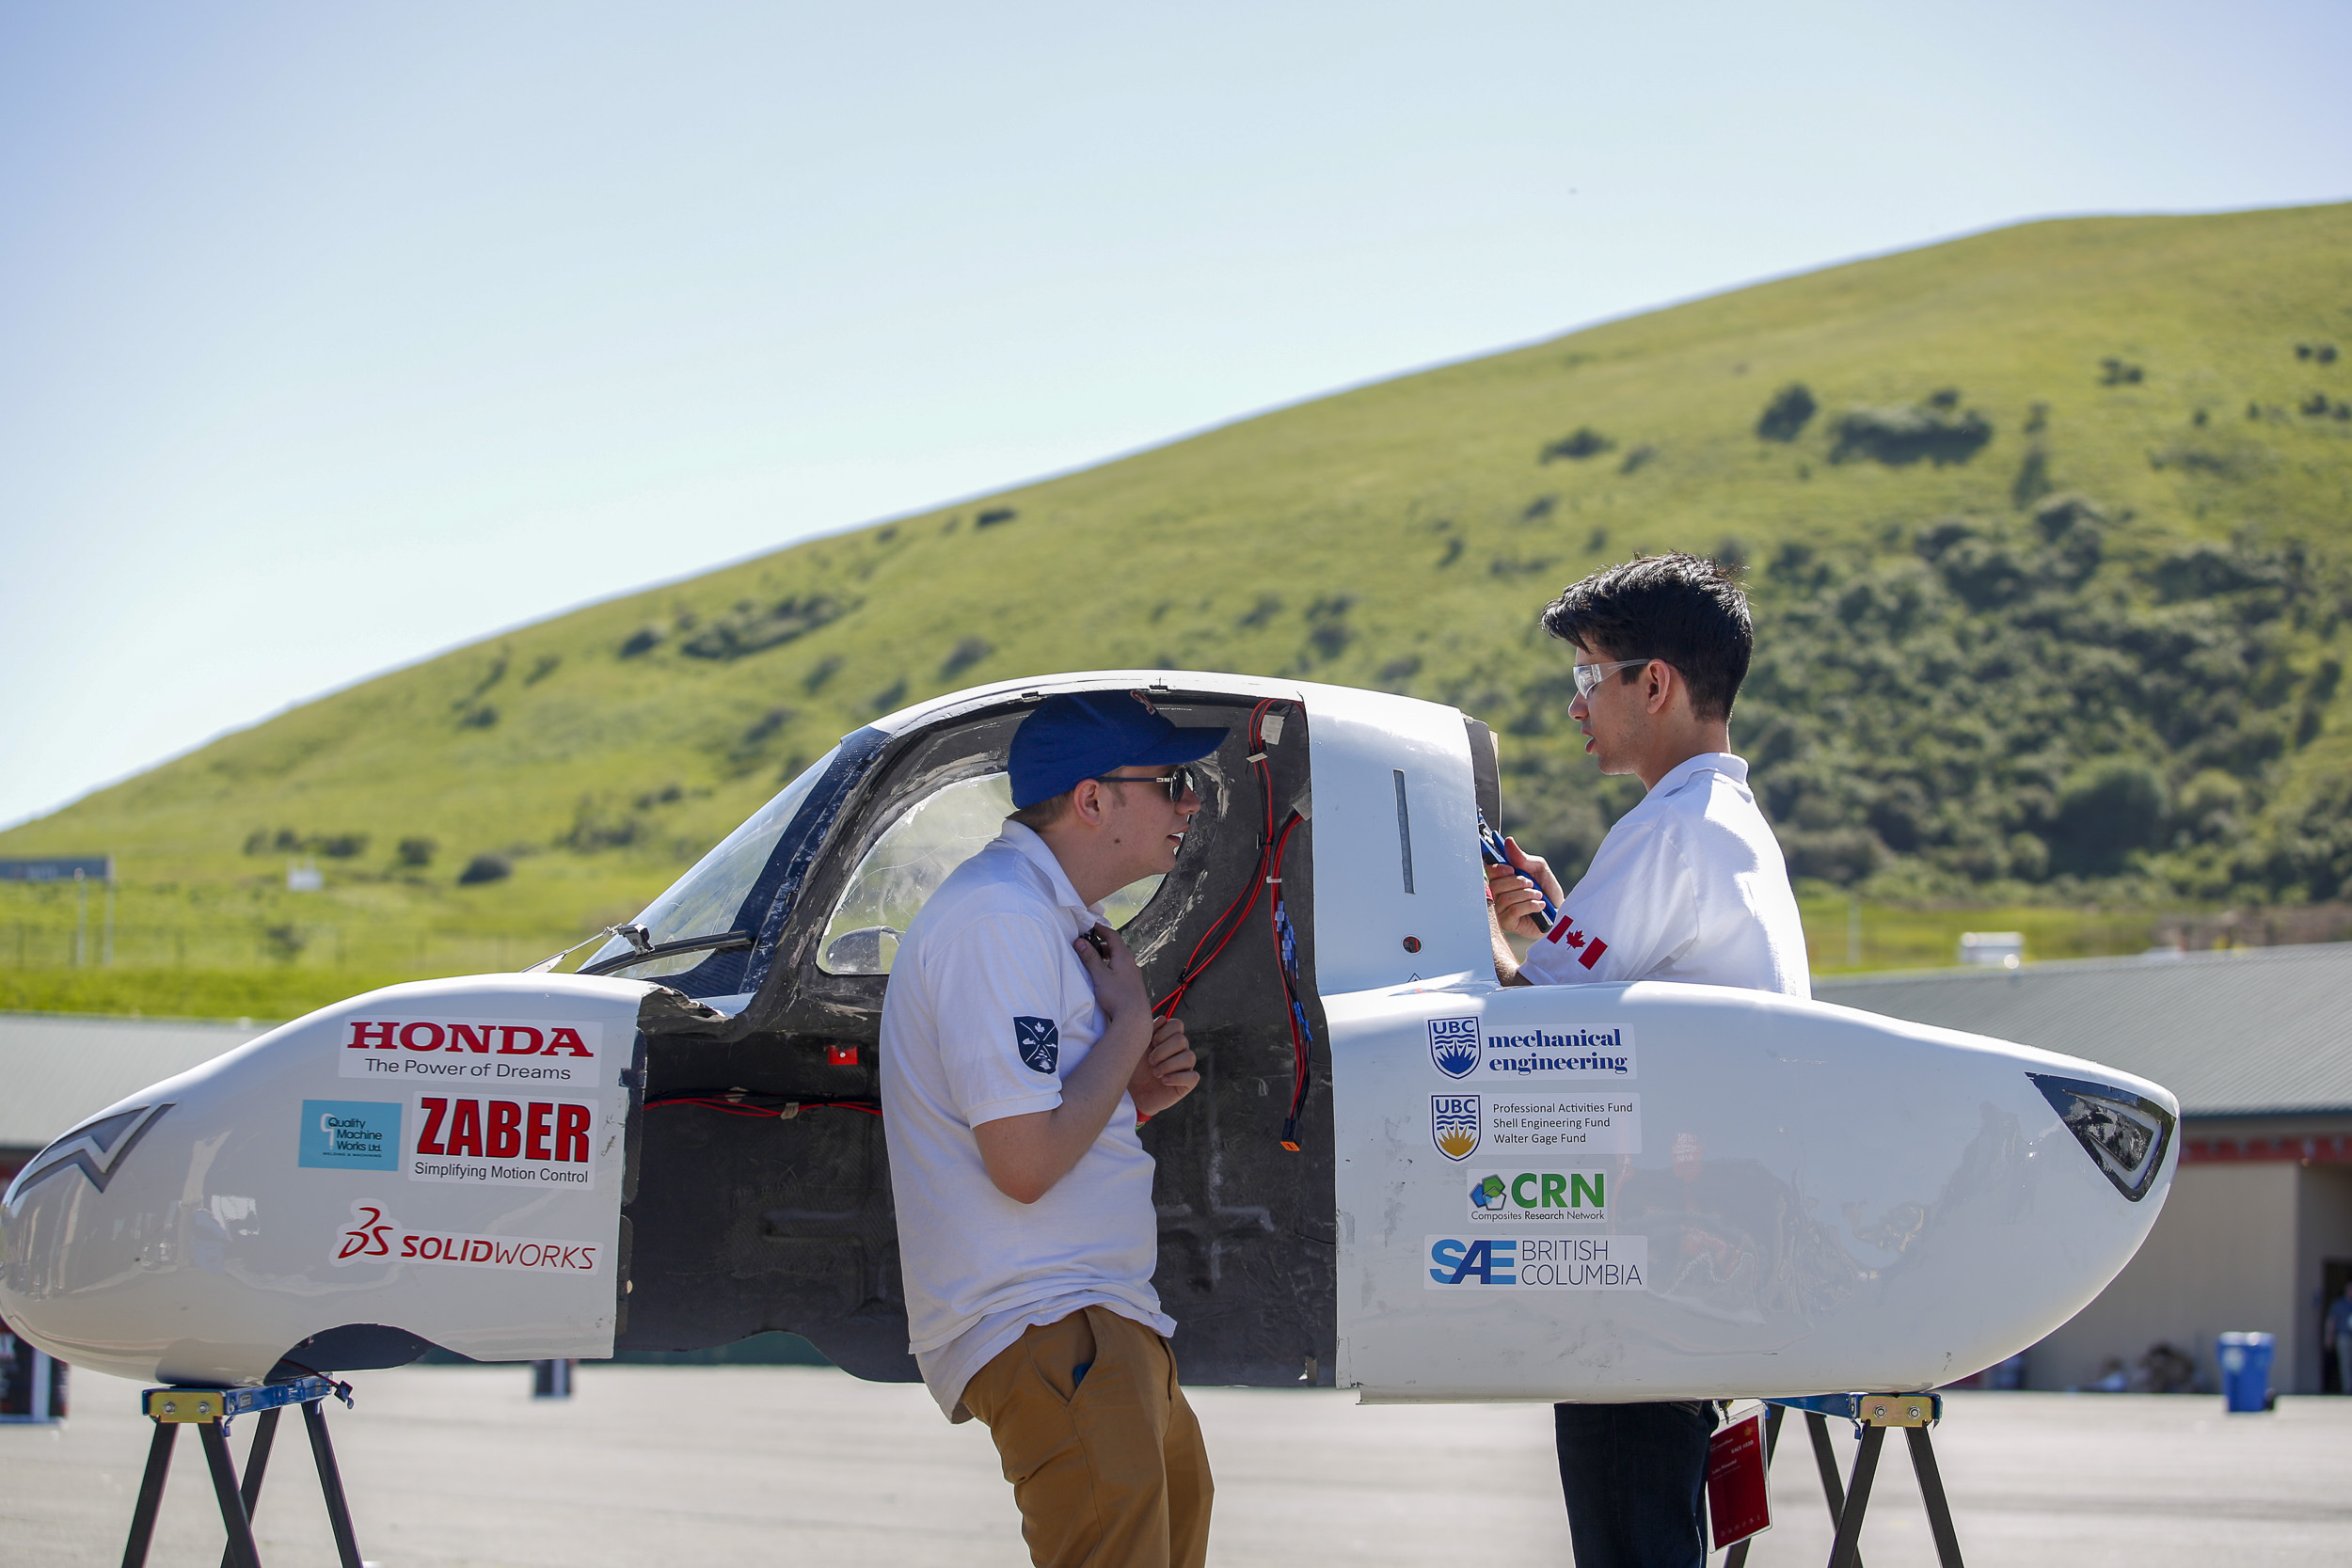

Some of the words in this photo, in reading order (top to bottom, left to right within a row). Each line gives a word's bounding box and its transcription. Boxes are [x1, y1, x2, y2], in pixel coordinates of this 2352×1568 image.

[1433, 1020, 1475, 1035] UBC
[347, 1022, 594, 1057] HONDA
[1488, 1029, 1622, 1048] mechanical
[365, 1058, 399, 1073] The
[405, 1060, 467, 1077] Power
[471, 1063, 491, 1077] of
[497, 1064, 571, 1080] Dreams
[1489, 1052, 1628, 1075] engineering
[1436, 1099, 1477, 1114] UBC
[1493, 1103, 1555, 1114] Professional
[1558, 1102, 1605, 1113] Activities
[1608, 1102, 1633, 1113] Fund
[328, 1117, 366, 1129] Quality
[417, 1097, 591, 1163] ZABER
[1493, 1117, 1518, 1128] Shell
[1521, 1117, 1582, 1130] Engineering
[1585, 1117, 1611, 1128] Fund
[337, 1130, 382, 1140] Machine
[1493, 1132, 1529, 1144] Walter
[1531, 1133, 1558, 1145] Gage
[1561, 1132, 1586, 1143] Fund
[337, 1141, 366, 1151] Works
[368, 1144, 382, 1152] Ltd.
[415, 1162, 486, 1180] Simplifying
[491, 1165, 535, 1180] Motion
[540, 1168, 588, 1183] Control
[1511, 1173, 1605, 1209] CRN
[1471, 1211, 1521, 1222] Composites
[1524, 1211, 1565, 1220] Research
[1567, 1211, 1605, 1220] Network
[401, 1235, 596, 1270] SOLIDWORKS
[1522, 1240, 1608, 1261] BRITISH
[1430, 1239, 1517, 1285] SAE
[1521, 1264, 1643, 1286] COLUMBIA
